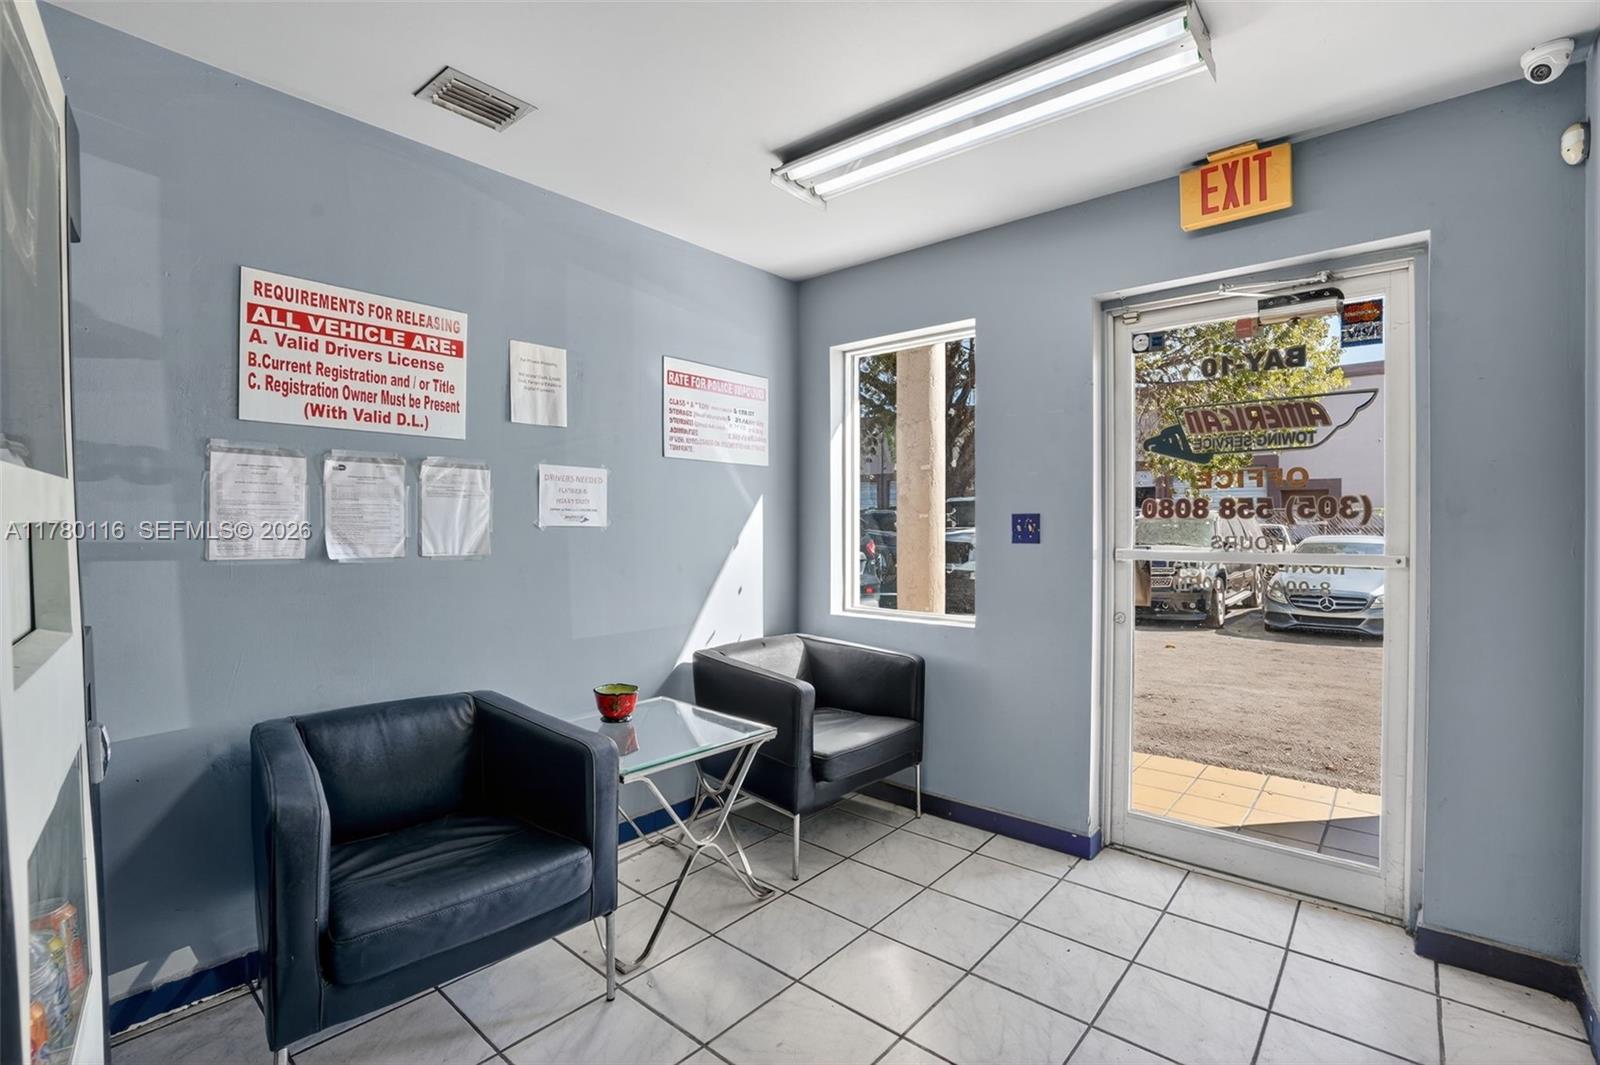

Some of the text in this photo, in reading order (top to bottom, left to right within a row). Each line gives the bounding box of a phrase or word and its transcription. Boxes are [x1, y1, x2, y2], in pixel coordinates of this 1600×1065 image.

[1200, 150, 1272, 216] EXIT
[253, 280, 461, 334] REQUIREMENTS FOR RELEASING
[249, 329, 445, 373] A. Valid Drivers License
[251, 306, 457, 356] ALL VEHICLE ARE:
[247, 352, 312, 375] B.Current
[315, 362, 387, 386] Registration
[390, 375, 410, 389] and
[419, 380, 430, 391] or
[433, 379, 455, 394] Title
[247, 372, 460, 414] C. Registration Owner Must be Present
[668, 372, 689, 386] RATE
[691, 376, 706, 390] FOR
[303, 402, 429, 431] (With Valid D.L.)
[544, 473, 603, 485] DRIVERS NEEDED
